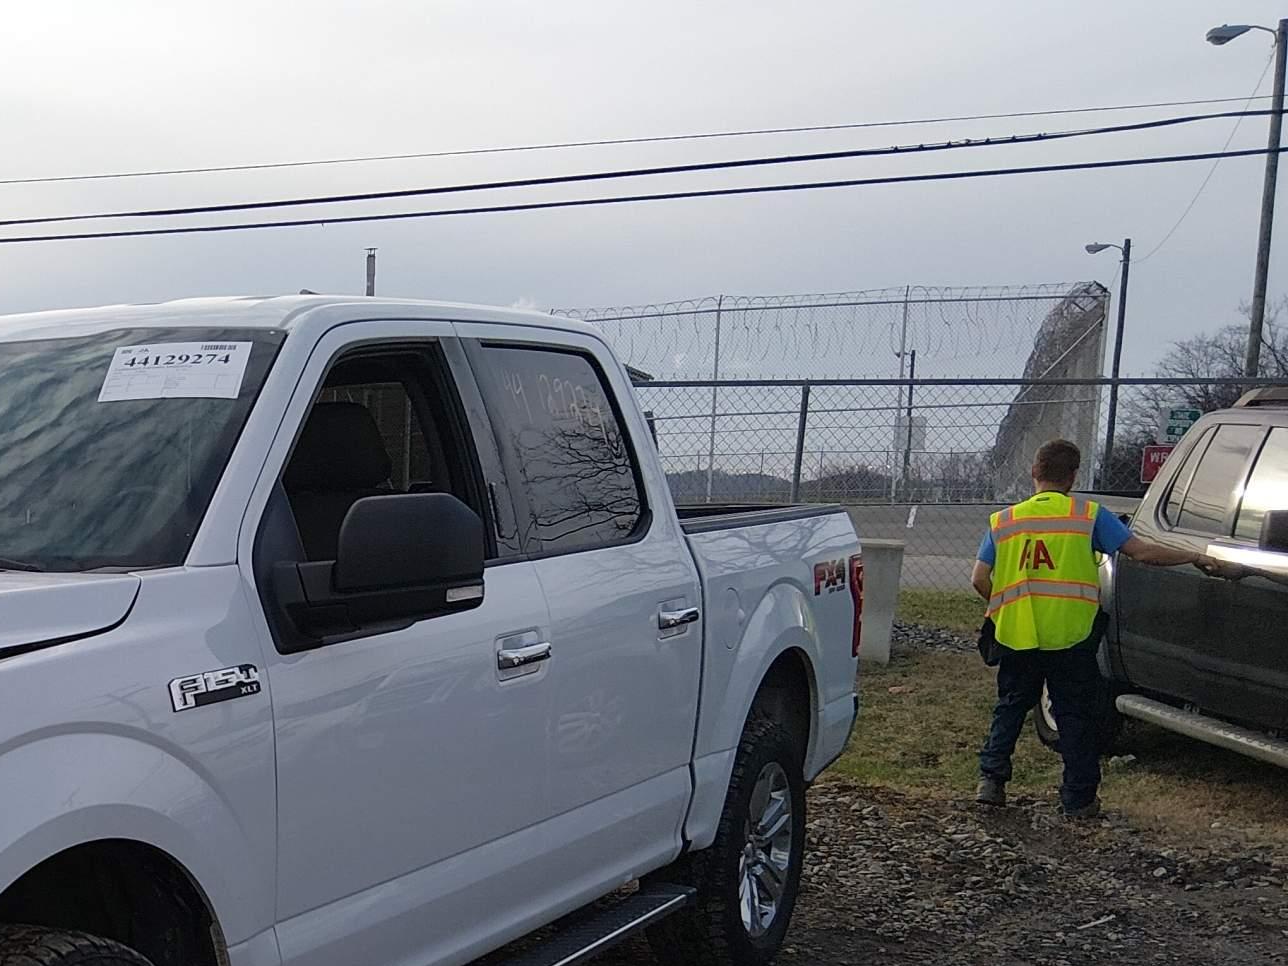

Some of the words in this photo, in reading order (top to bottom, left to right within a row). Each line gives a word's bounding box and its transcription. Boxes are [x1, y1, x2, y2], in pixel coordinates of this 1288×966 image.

[123, 352, 231, 368] 44129274
[814, 559, 845, 596] FX4
[240, 684, 259, 695] XLT
